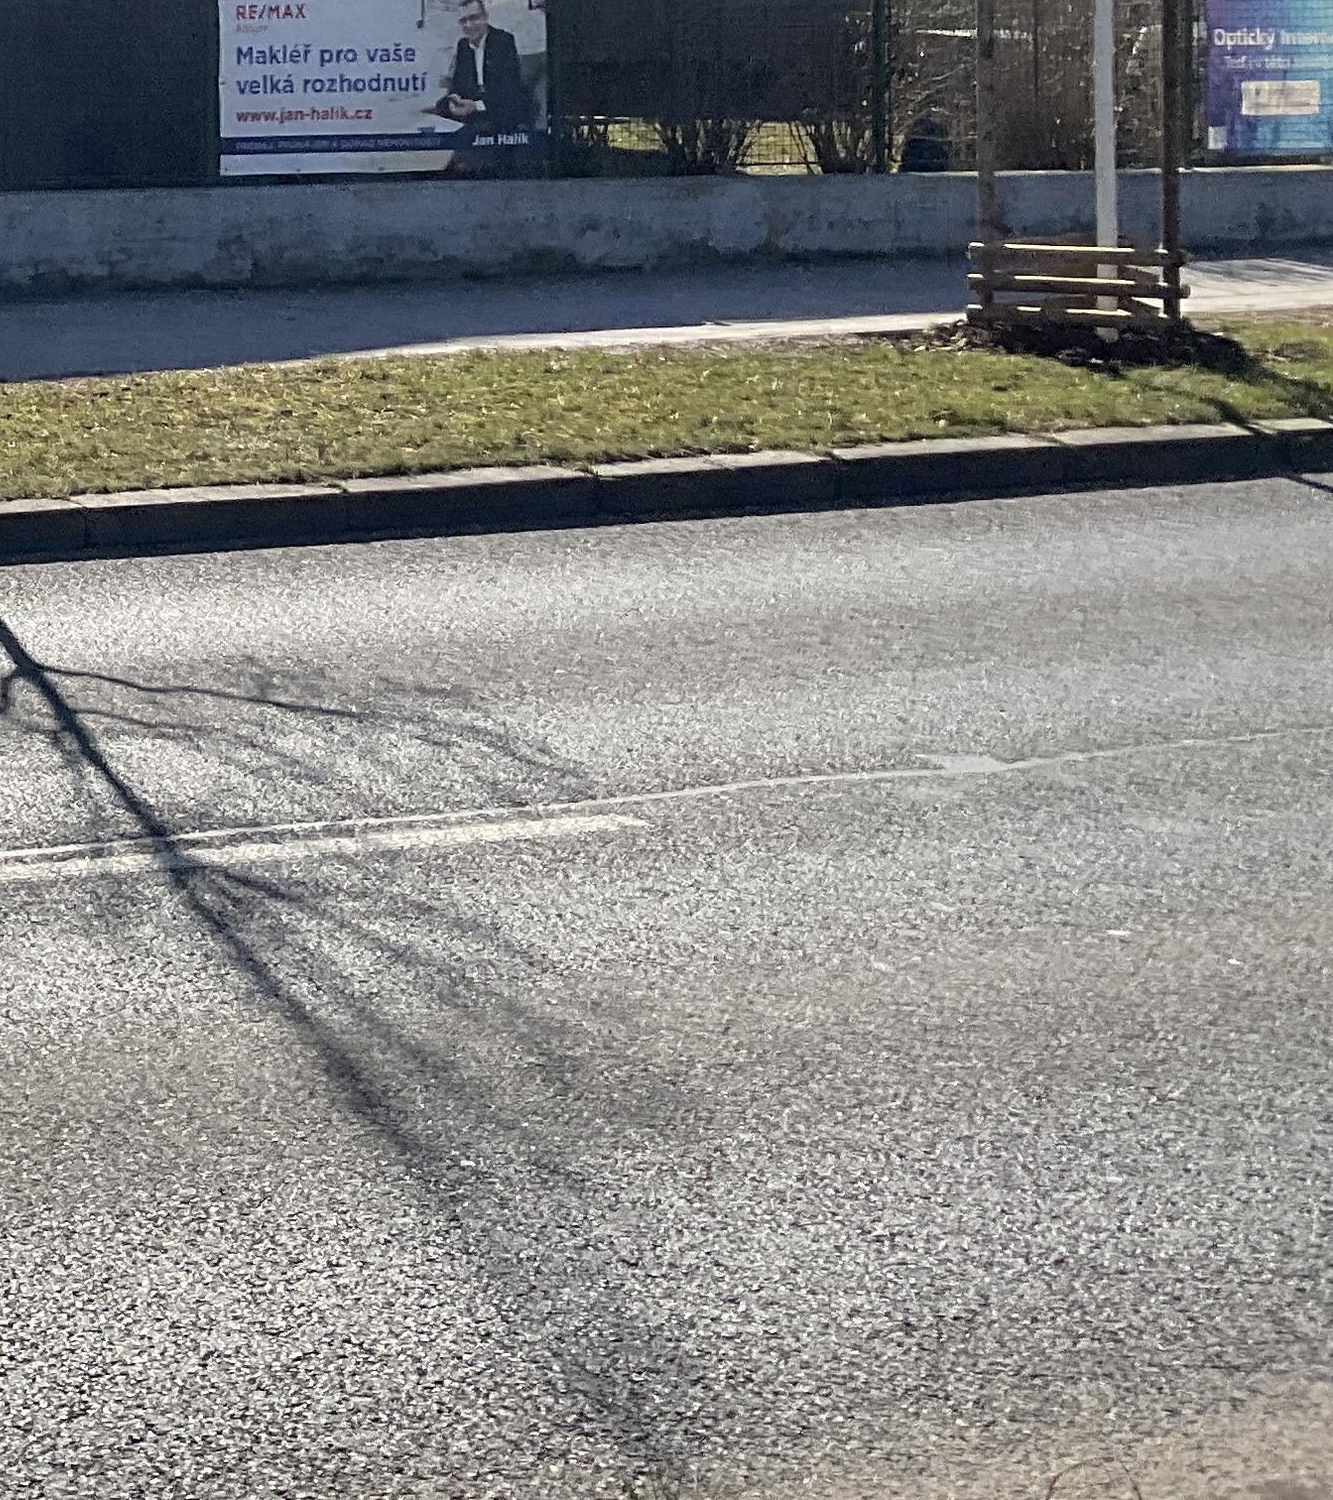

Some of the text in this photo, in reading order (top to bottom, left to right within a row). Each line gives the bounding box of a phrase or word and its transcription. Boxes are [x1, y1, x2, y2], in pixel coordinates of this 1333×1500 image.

[235, 4, 307, 20] RE/MAX
[236, 42, 417, 68] Makléř pro vaše
[236, 72, 429, 95] velká rozhodnutí
